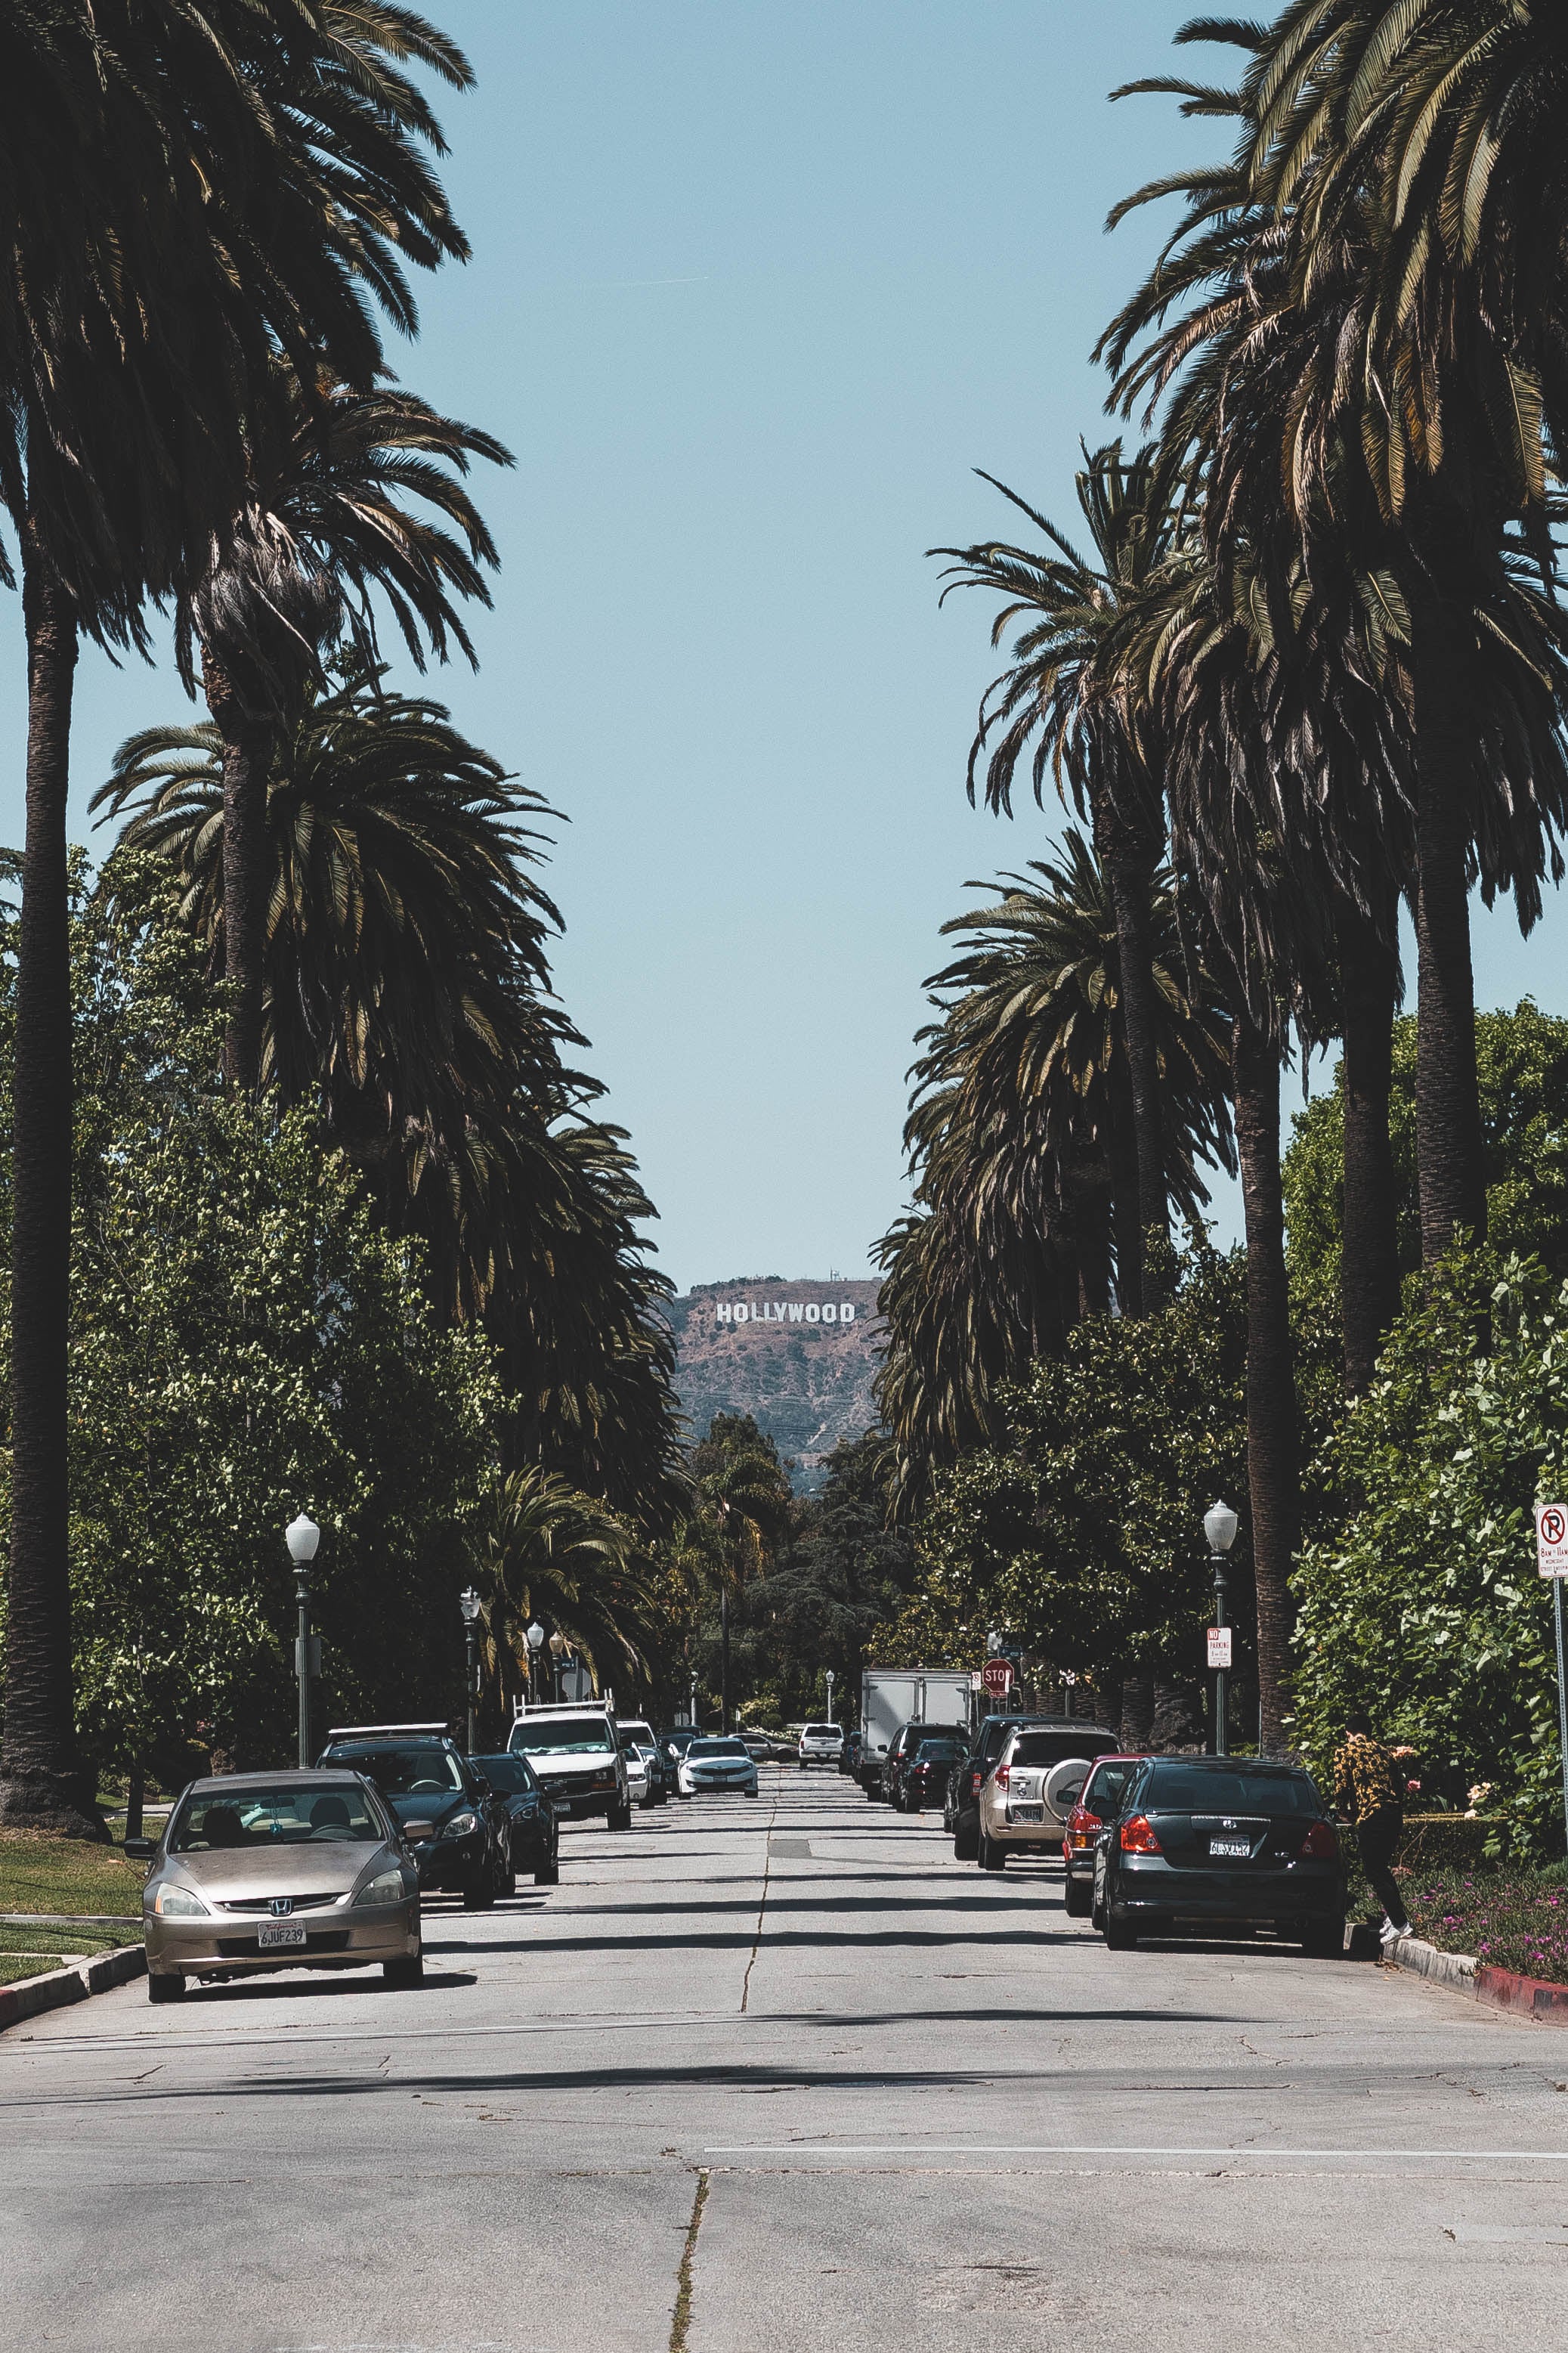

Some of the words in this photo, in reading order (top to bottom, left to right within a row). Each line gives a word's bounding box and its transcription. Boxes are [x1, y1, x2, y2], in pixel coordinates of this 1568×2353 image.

[717, 1302, 855, 1323] HOLLYWOOD
[1209, 1630, 1218, 1639] NO
[261, 1928, 303, 1944] 6JUF239
